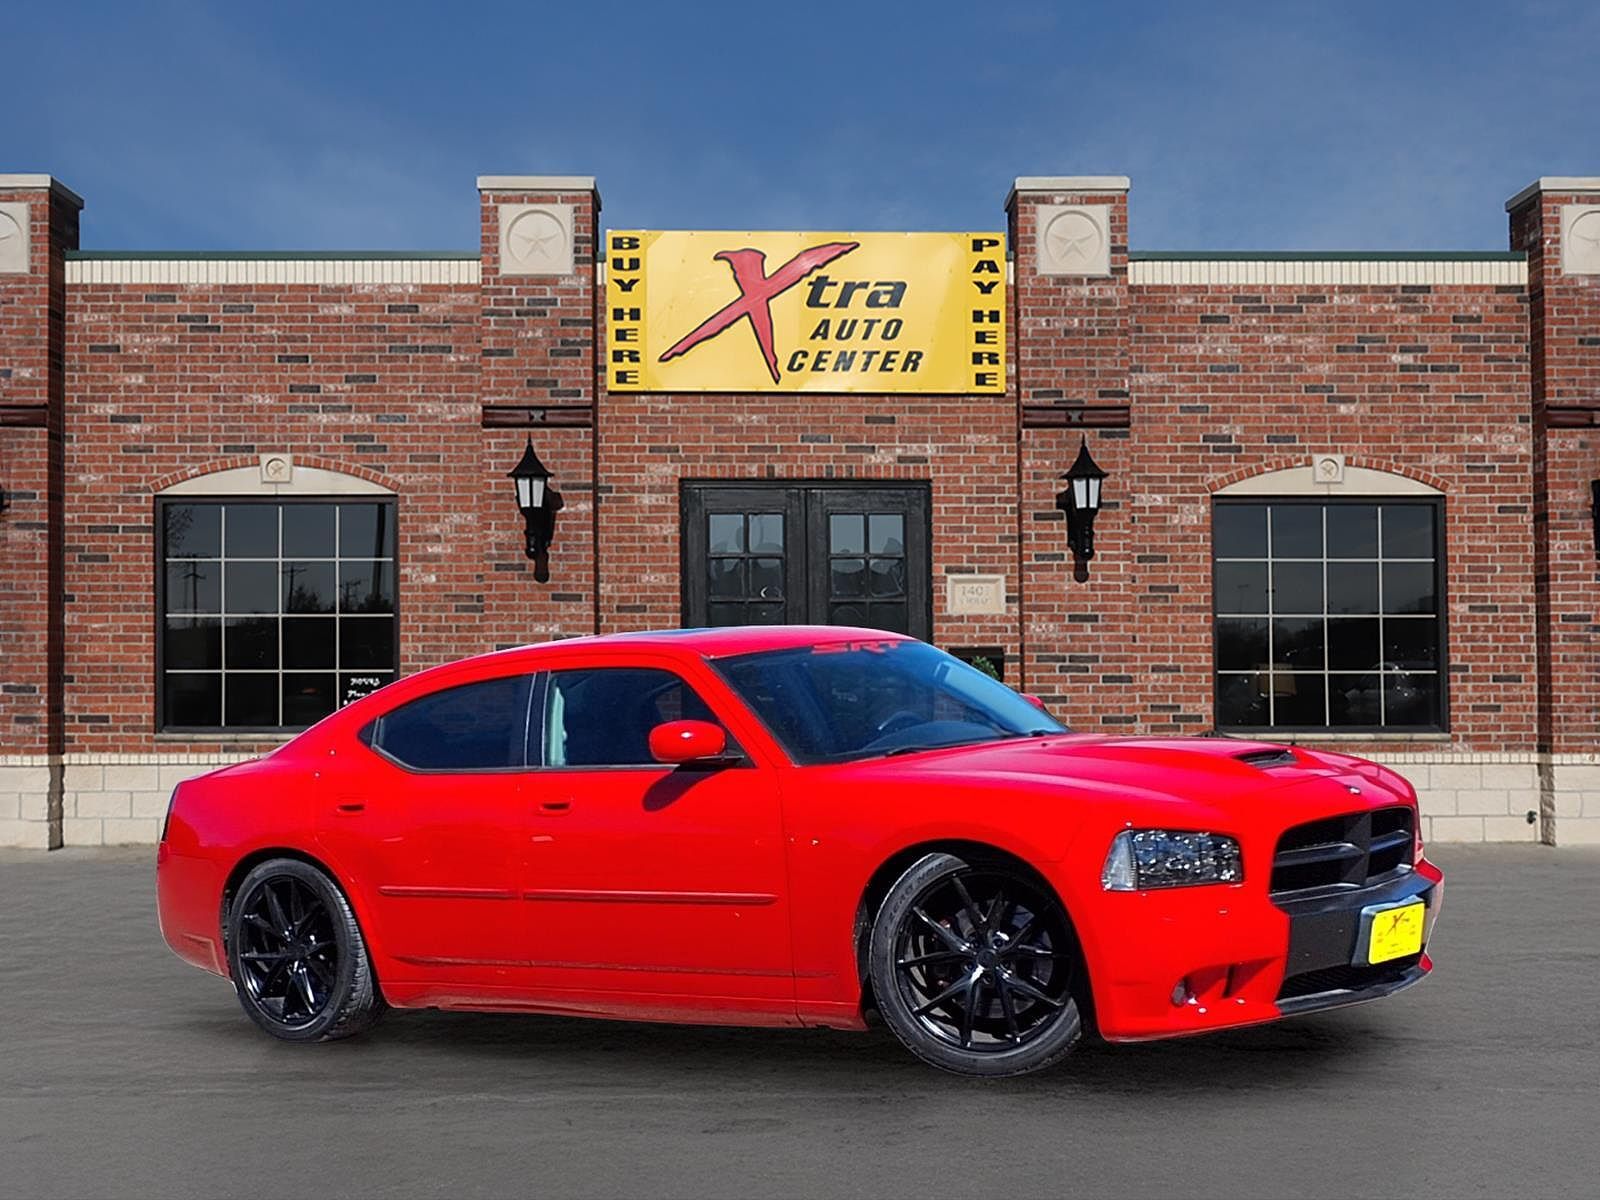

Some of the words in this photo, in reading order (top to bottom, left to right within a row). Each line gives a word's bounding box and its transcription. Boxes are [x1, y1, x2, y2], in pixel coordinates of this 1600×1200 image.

[611, 236, 641, 292] BUY
[971, 238, 1000, 294] PAY
[611, 307, 641, 385] HERE
[809, 318, 904, 341] AUTO
[971, 309, 1000, 387] HERE
[786, 350, 924, 372] CENTER
[811, 640, 901, 655] SRT
